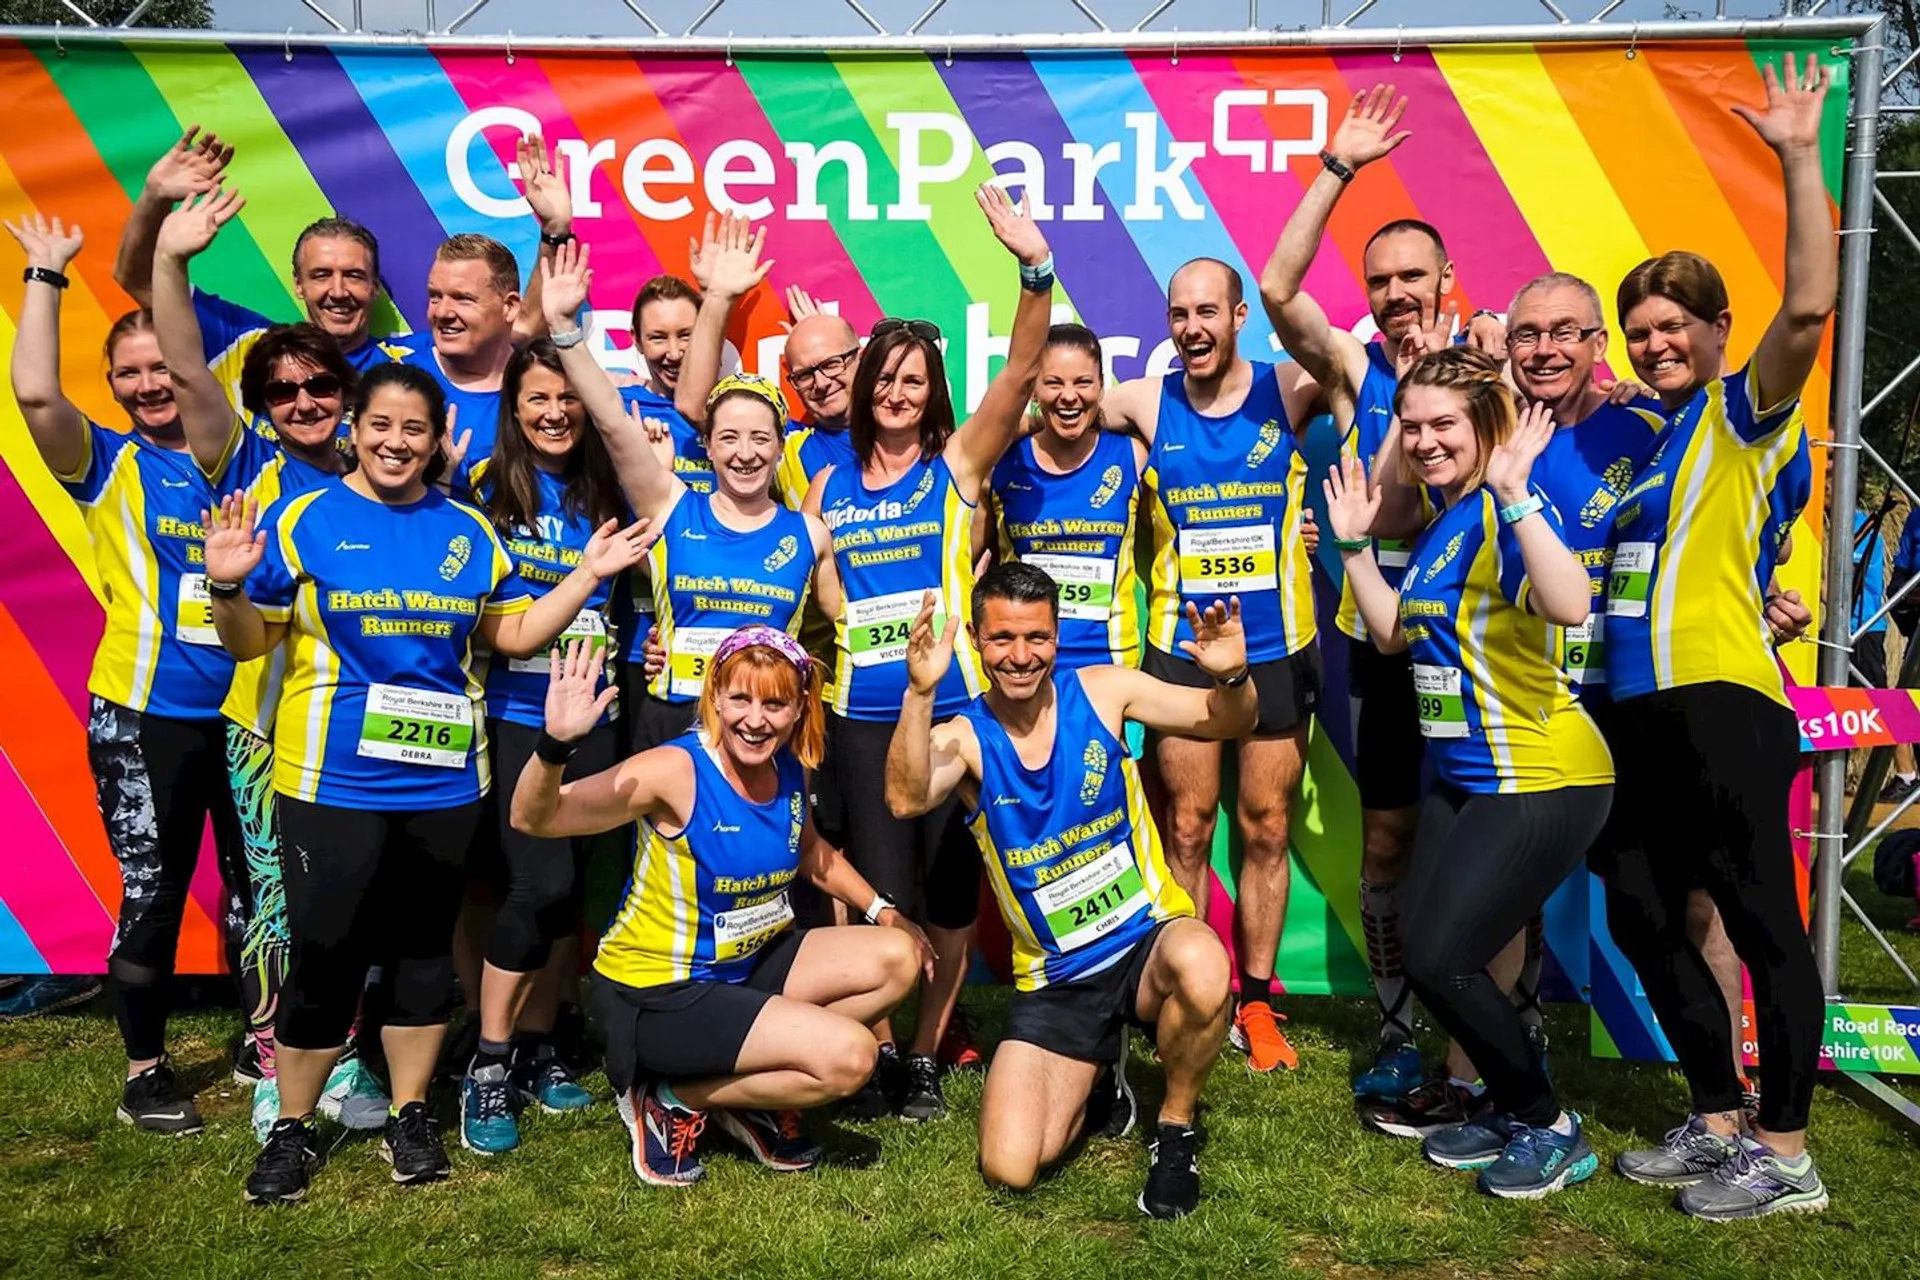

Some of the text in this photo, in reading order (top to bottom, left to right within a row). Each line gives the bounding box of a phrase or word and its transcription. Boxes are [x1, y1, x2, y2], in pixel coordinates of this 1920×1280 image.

[445, 107, 1205, 222] GreenPark
[1166, 481, 1284, 505] Hatch Warren
[1186, 504, 1263, 523] Runners
[157, 515, 208, 538] Hatc
[875, 522, 941, 543] Warren
[1009, 519, 1125, 537] Hatch Warren
[848, 544, 922, 567] Runners
[1030, 540, 1105, 554] Runners
[1199, 556, 1255, 576] 3536
[674, 574, 796, 602] Hatch Warren
[1055, 583, 1092, 602] 759
[1217, 581, 1239, 589] RORY
[328, 589, 477, 615] Hatch Warren
[694, 595, 773, 617] Runners
[361, 615, 455, 637] Runners
[869, 622, 911, 646] 324
[880, 648, 907, 659] VICTO
[1421, 697, 1442, 718] 99
[388, 720, 451, 745] 2216
[401, 749, 432, 760] DEBRA
[1004, 807, 1126, 867] Hatch Warren
[1033, 840, 1112, 885] Runners
[713, 874, 767, 894] Hatch
[1068, 883, 1126, 927] 2411
[1096, 914, 1120, 932] CHRIS
[1833, 1017, 1920, 1037] Road Rac
